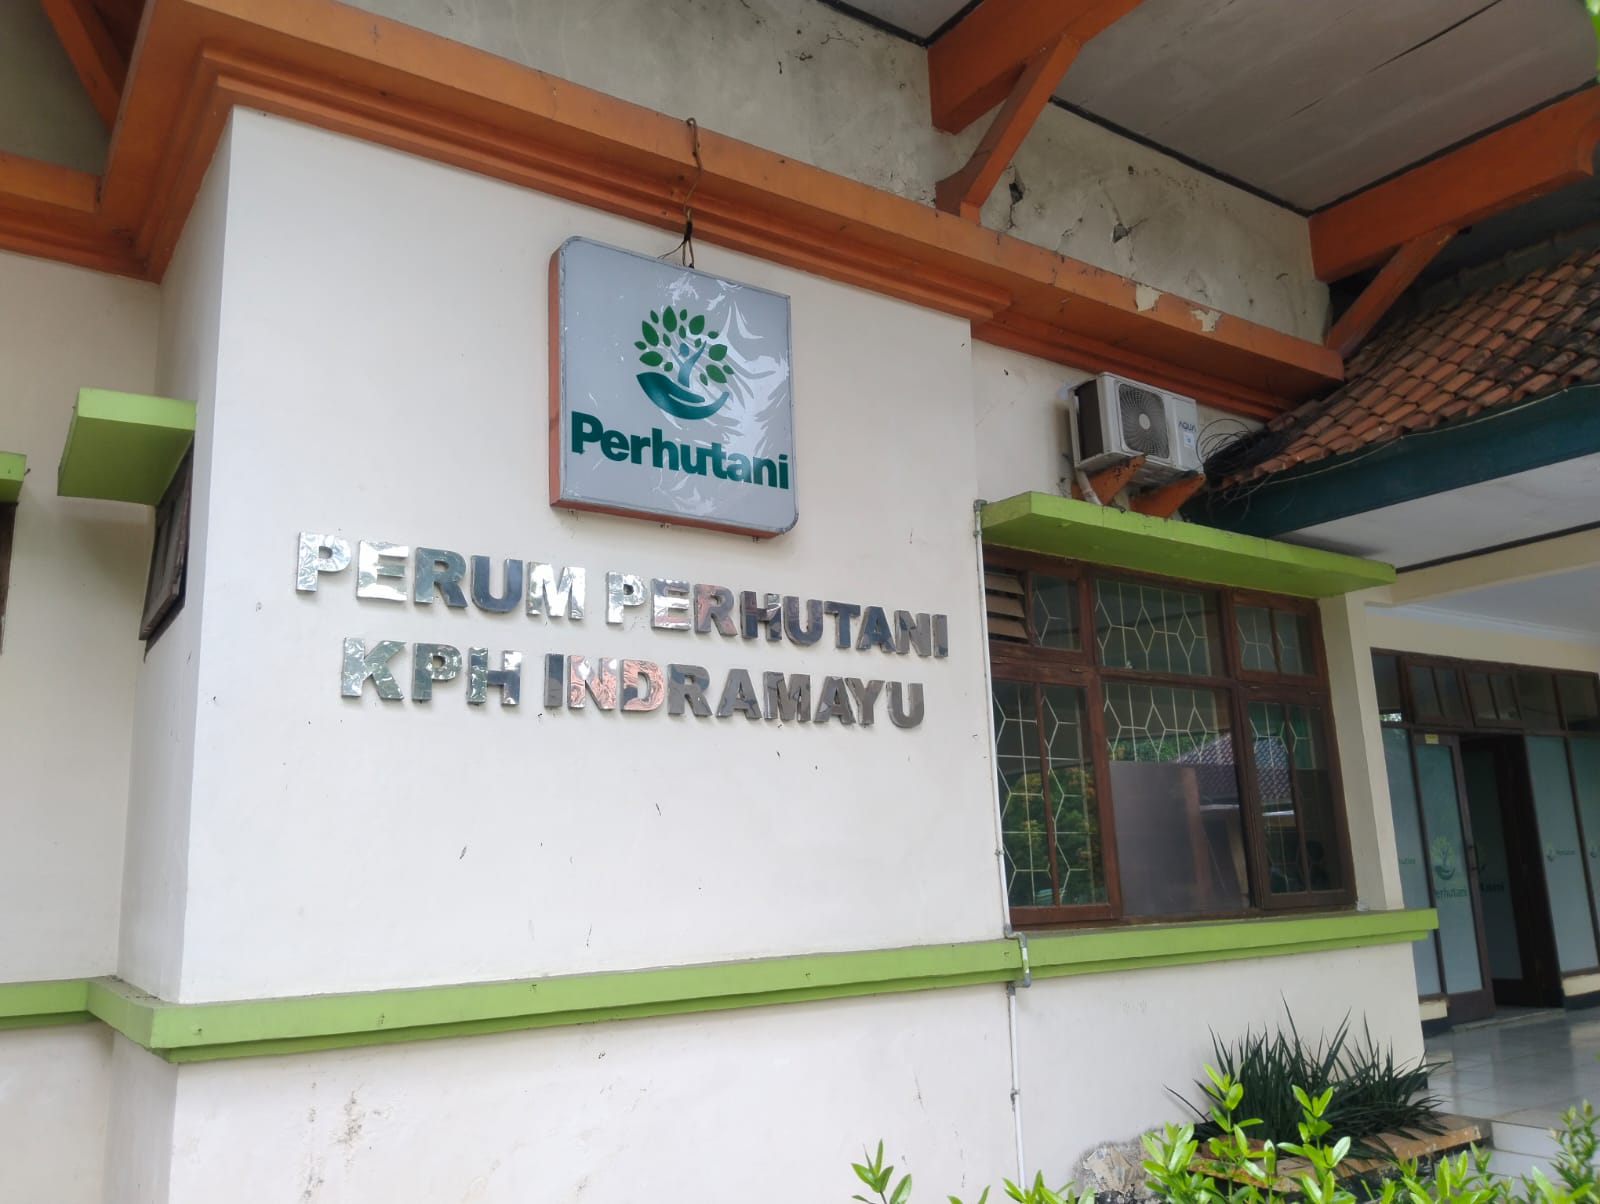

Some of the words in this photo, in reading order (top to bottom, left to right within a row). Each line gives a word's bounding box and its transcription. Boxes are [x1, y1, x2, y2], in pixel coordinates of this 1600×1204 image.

[571, 410, 789, 490] Perhutani
[1178, 420, 1197, 433] AQUA
[296, 531, 586, 621] PERUM
[605, 571, 949, 659] PERHUTANI
[341, 636, 522, 707] KPH
[544, 652, 926, 729] INDRAMAYU
[1434, 885, 1468, 899] erhutani
